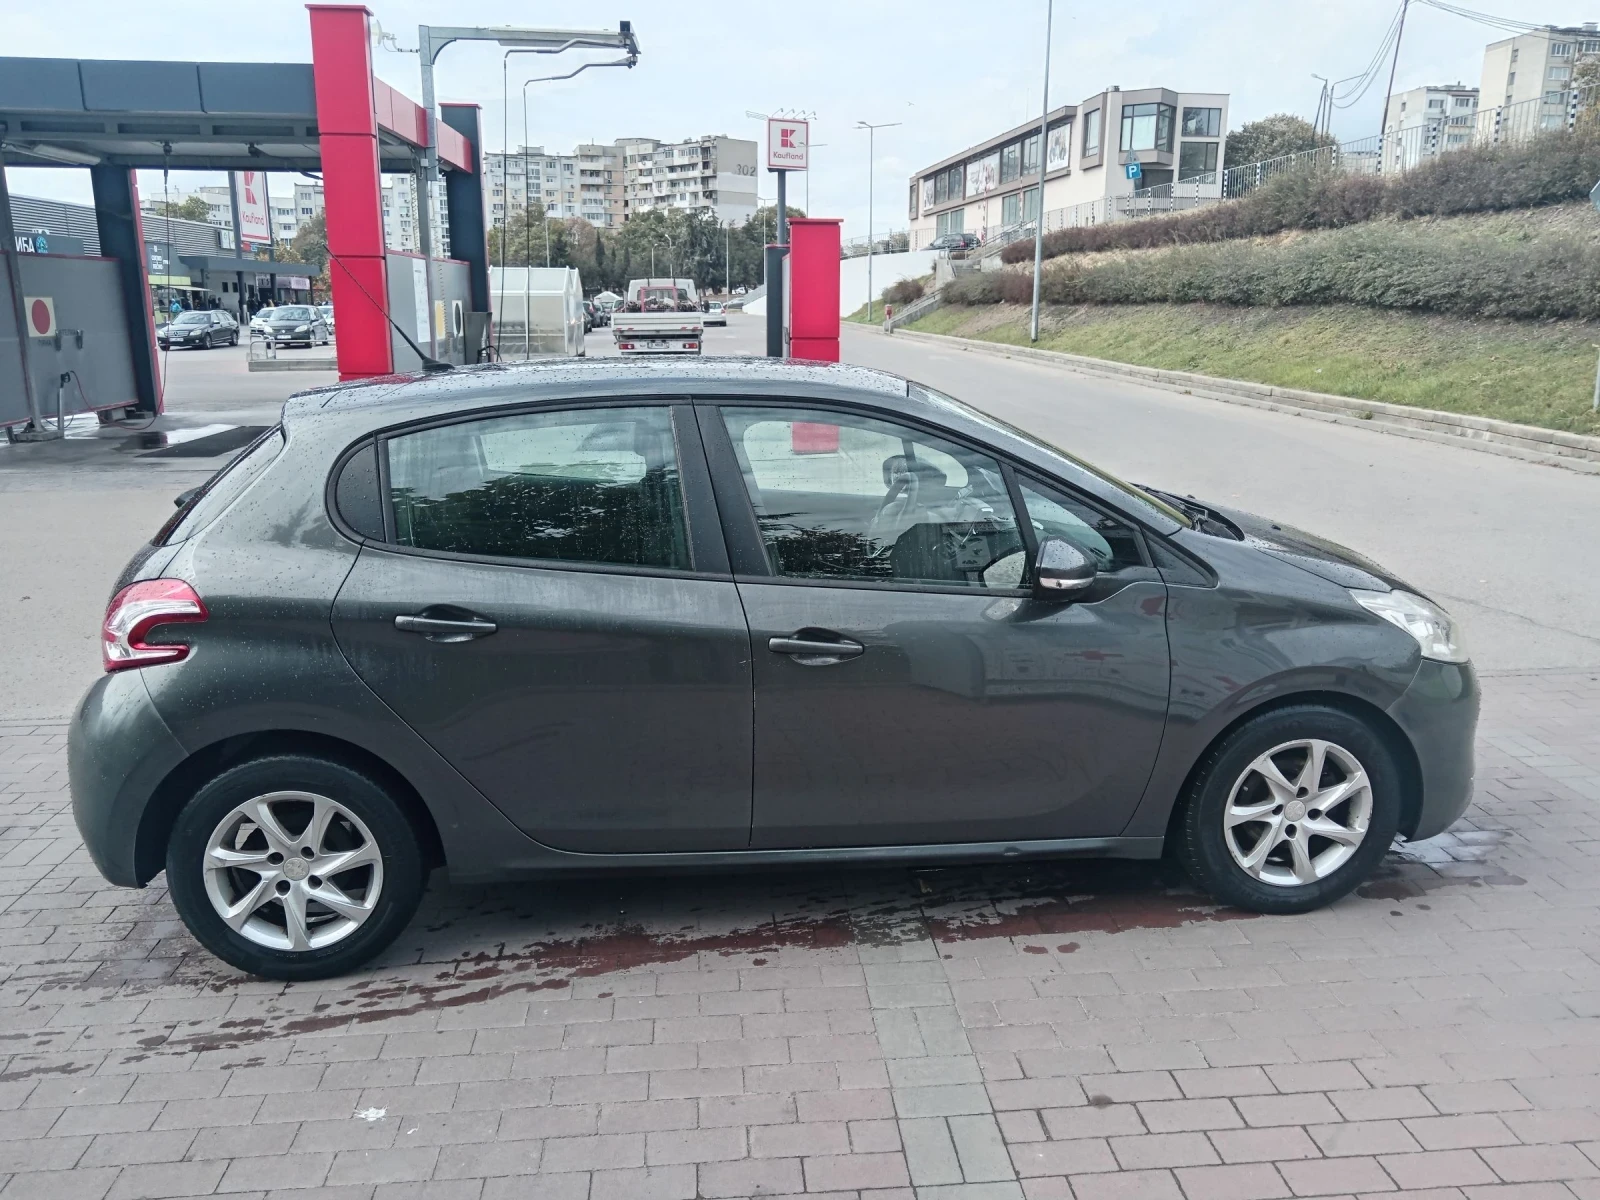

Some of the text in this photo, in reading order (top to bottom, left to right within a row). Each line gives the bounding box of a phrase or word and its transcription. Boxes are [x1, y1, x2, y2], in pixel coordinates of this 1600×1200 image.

[773, 151, 804, 160] Kaufland
[1129, 165, 1137, 178] P
[241, 210, 265, 226] Kaufland
